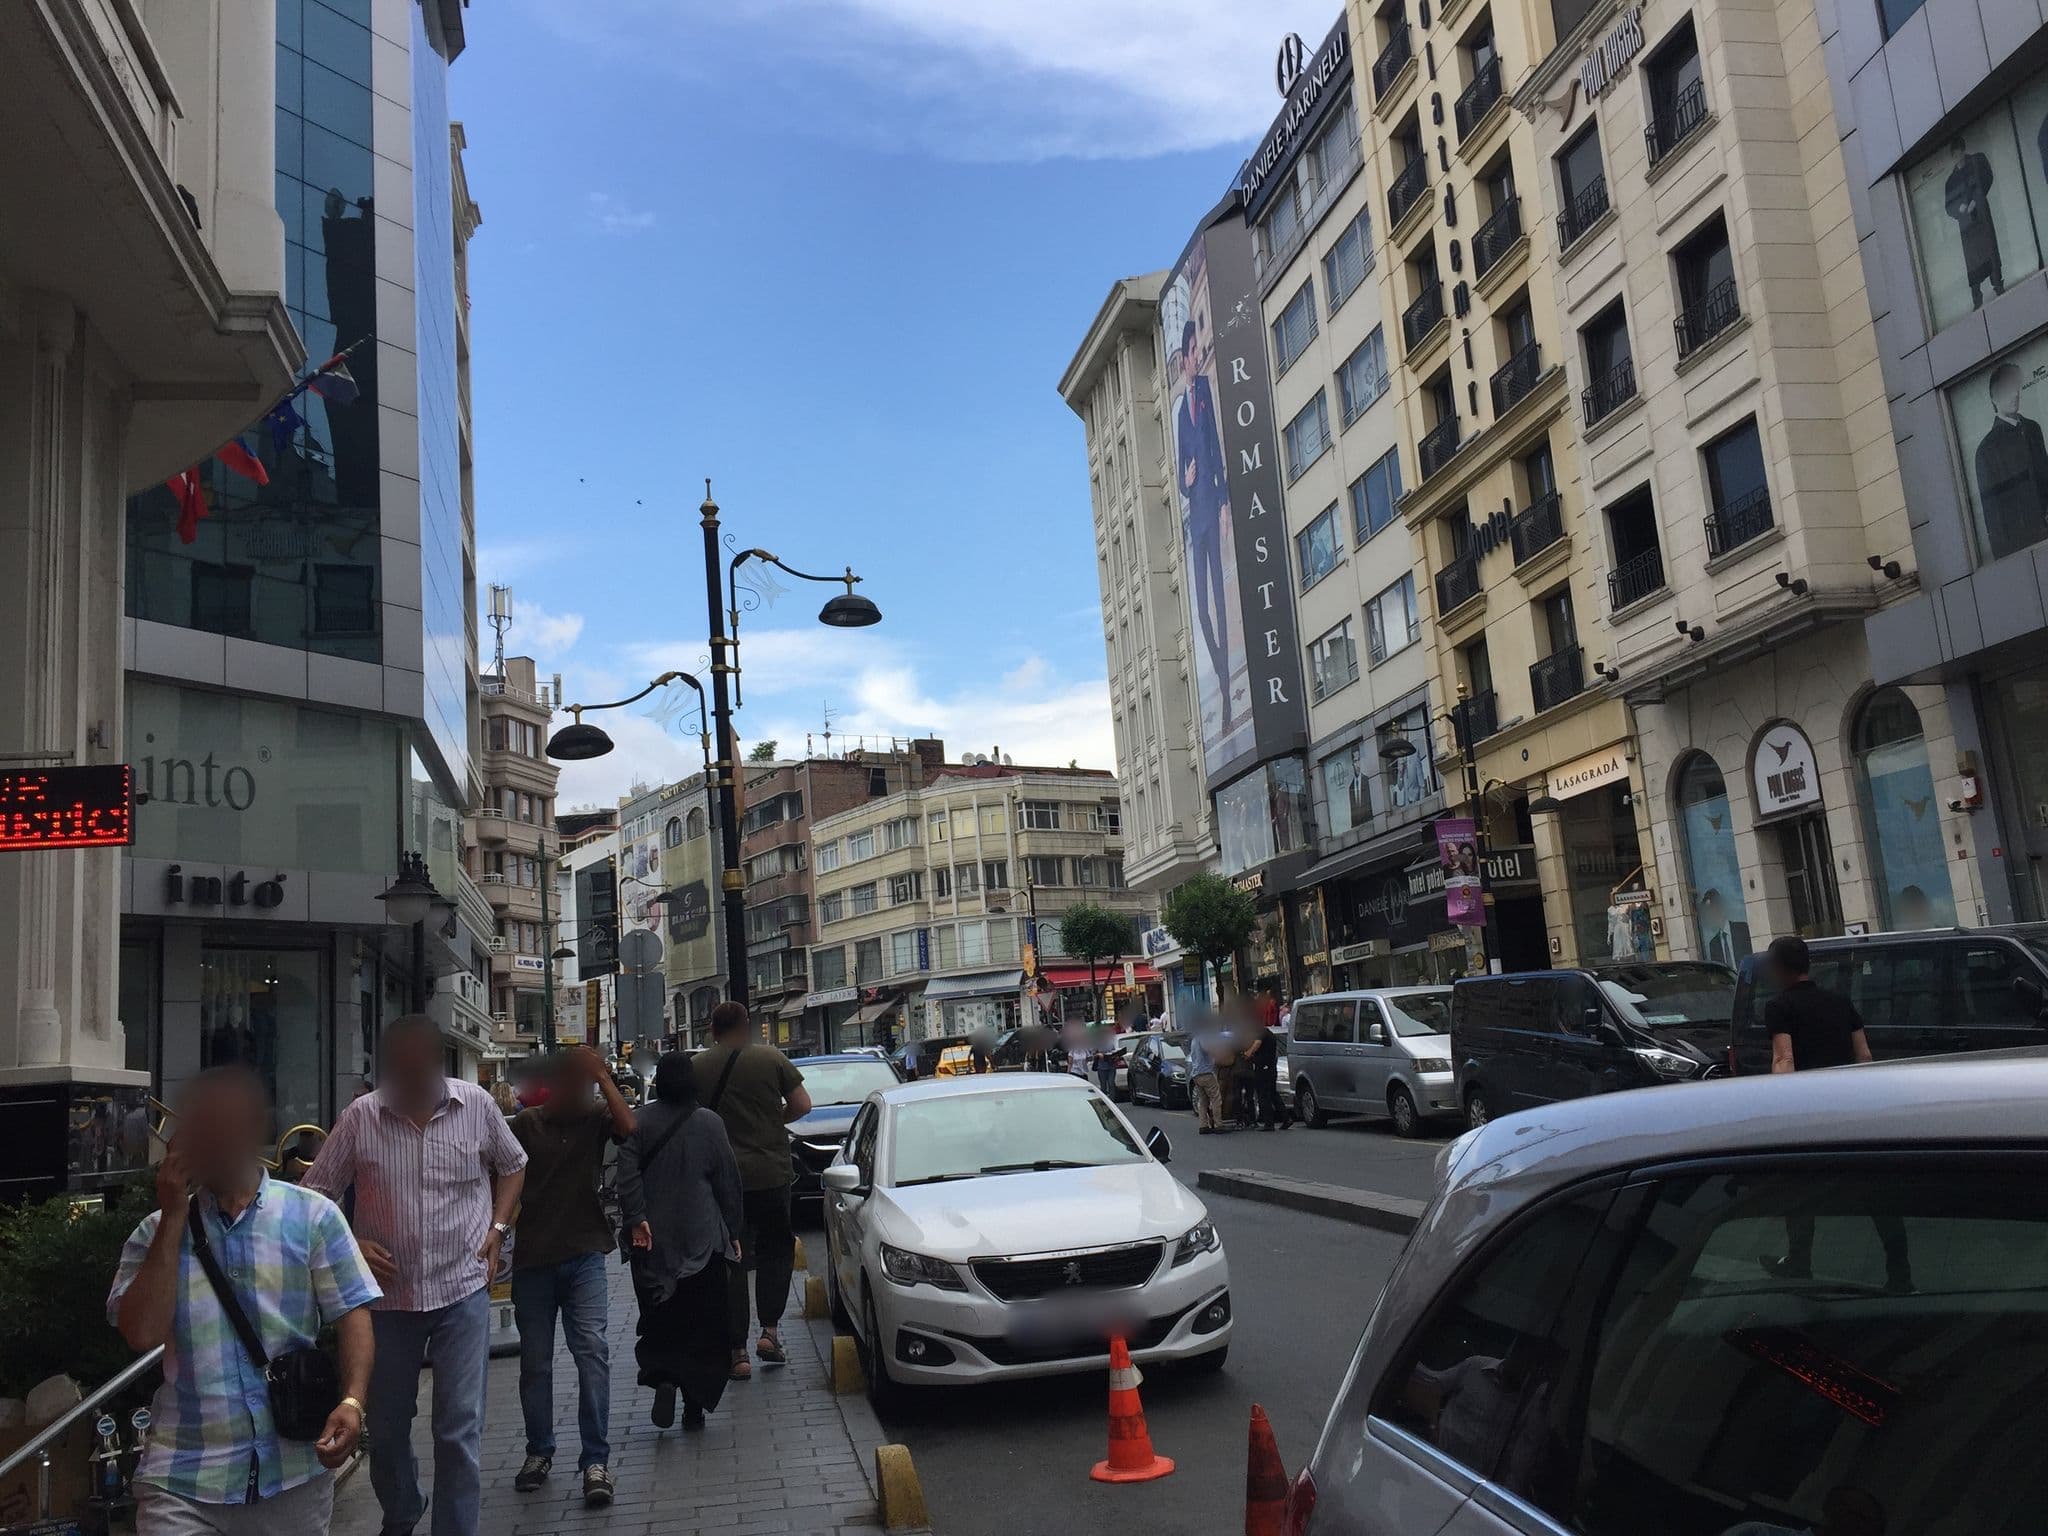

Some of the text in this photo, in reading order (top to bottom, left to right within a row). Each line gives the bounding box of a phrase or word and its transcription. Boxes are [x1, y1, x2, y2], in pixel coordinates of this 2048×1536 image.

[1243, 32, 1345, 207] DANIELE MARINELLI
[1231, 357, 1289, 705] ROMASTER
[141, 733, 256, 811] into
[1556, 757, 1619, 791] LASAGRADA
[167, 864, 285, 908] into
[1408, 872, 1426, 896] hotel
